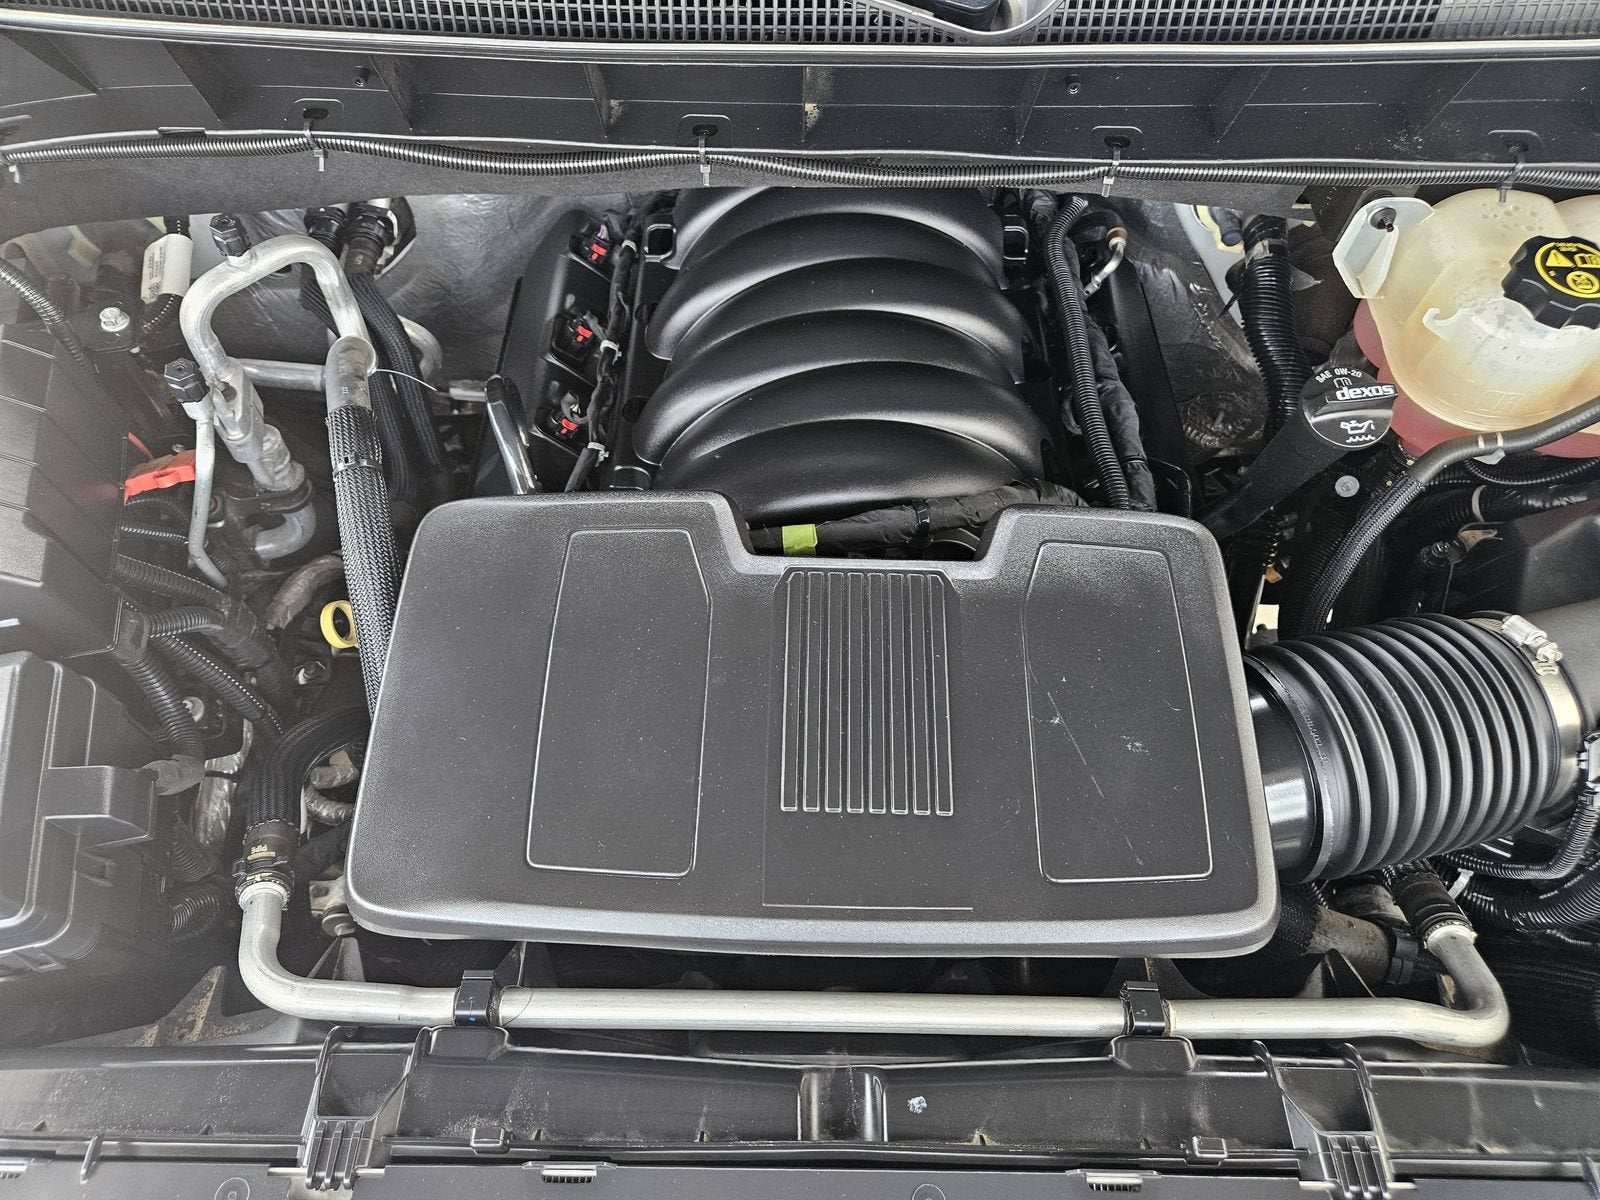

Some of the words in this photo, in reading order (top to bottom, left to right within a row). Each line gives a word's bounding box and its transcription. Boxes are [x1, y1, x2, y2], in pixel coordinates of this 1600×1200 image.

[1315, 370, 1332, 383] SAE
[1334, 367, 1362, 378] 0W-20
[1335, 384, 1395, 401] dexos
